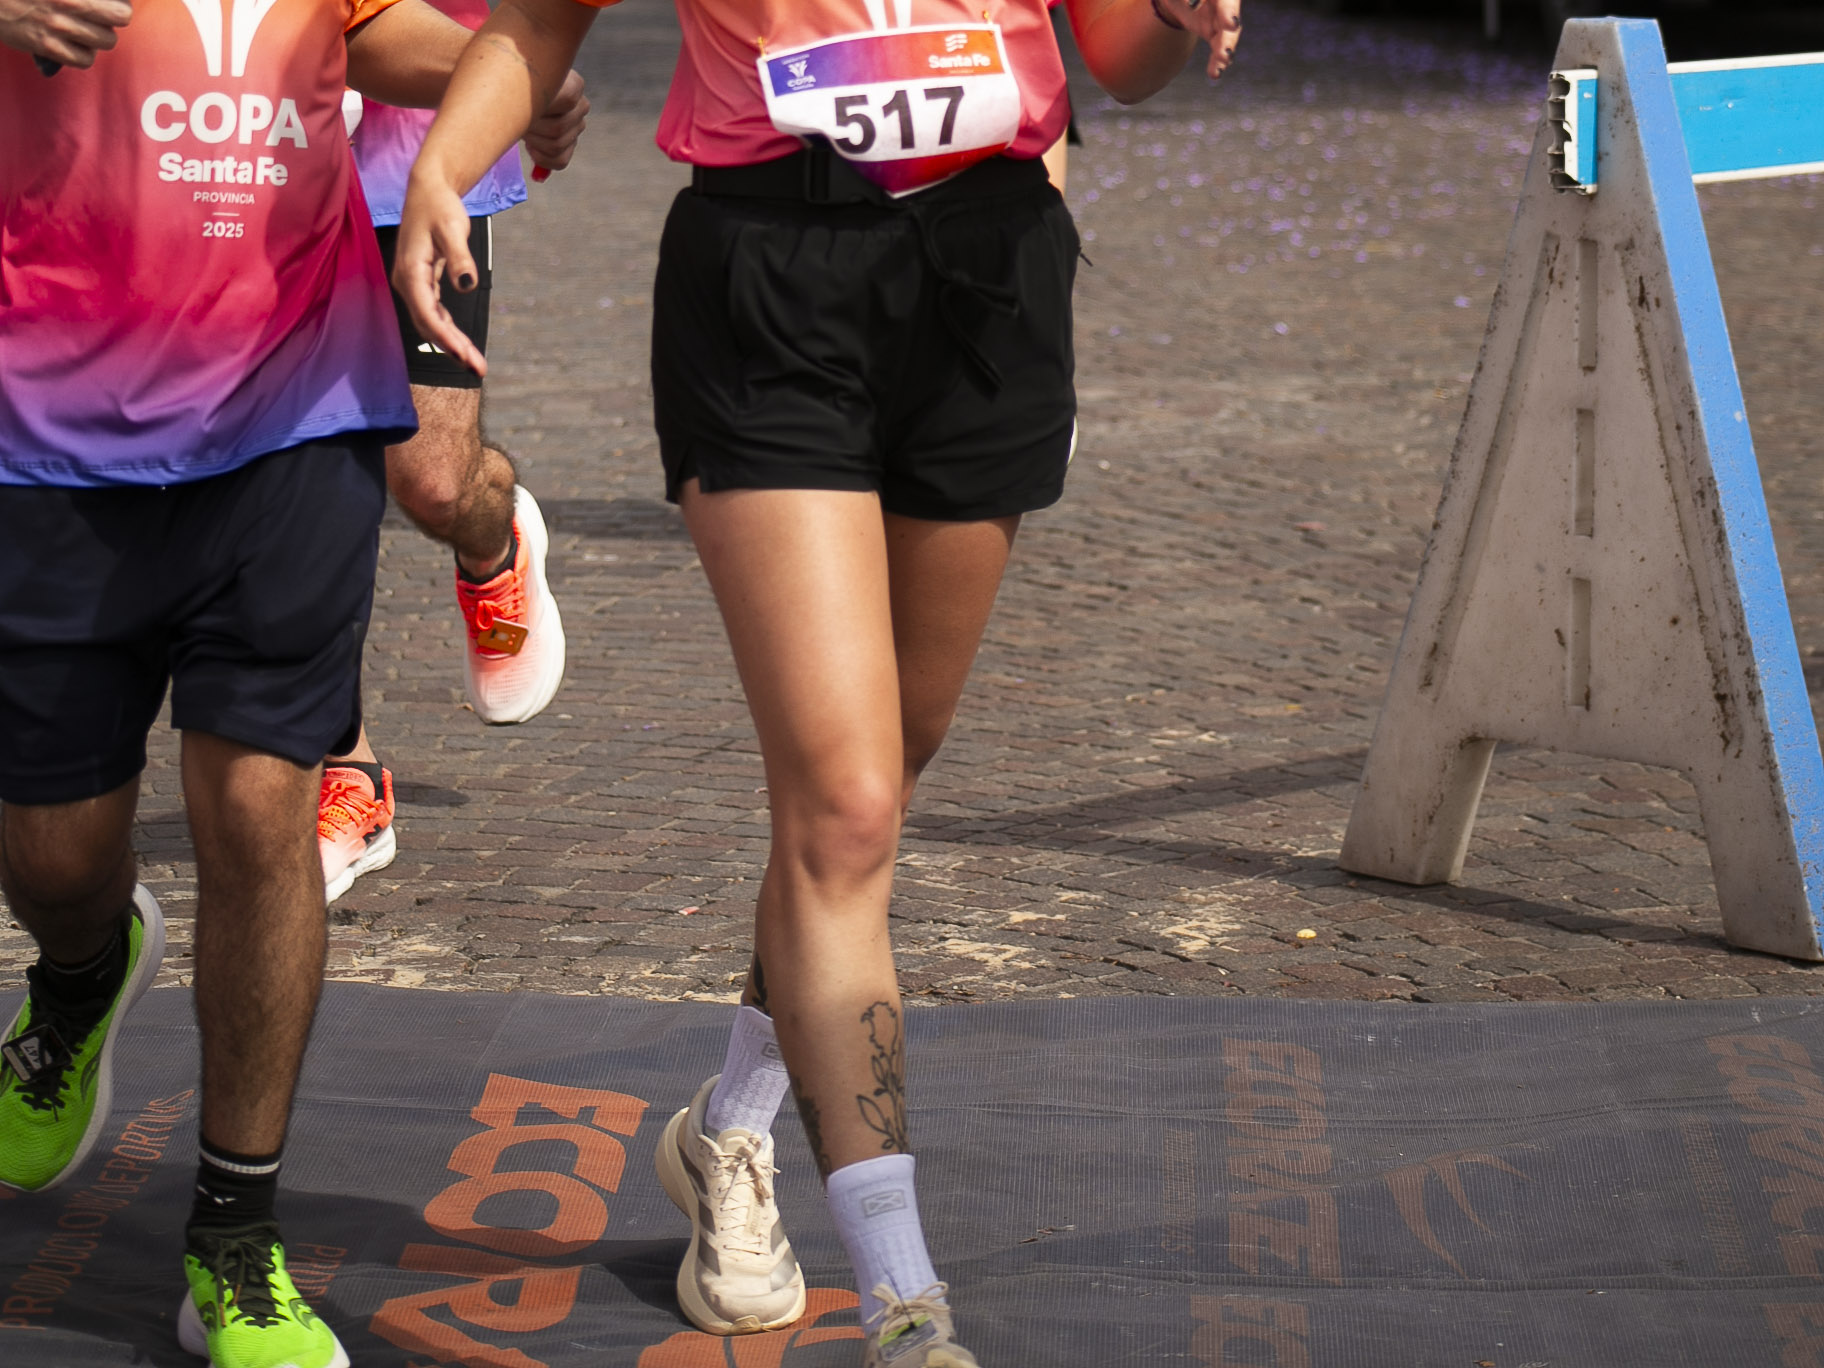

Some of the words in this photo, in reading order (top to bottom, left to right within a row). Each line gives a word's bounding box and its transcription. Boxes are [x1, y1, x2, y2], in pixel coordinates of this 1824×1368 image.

[928, 54, 972, 70] Santa
[972, 53, 991, 68] Fe
[140, 90, 308, 149] COPA
[834, 86, 966, 155] 517
[158, 152, 254, 185] Santa
[255, 156, 288, 187] Fe
[193, 191, 255, 205] PROVINCIA
[202, 221, 245, 238] 2025
